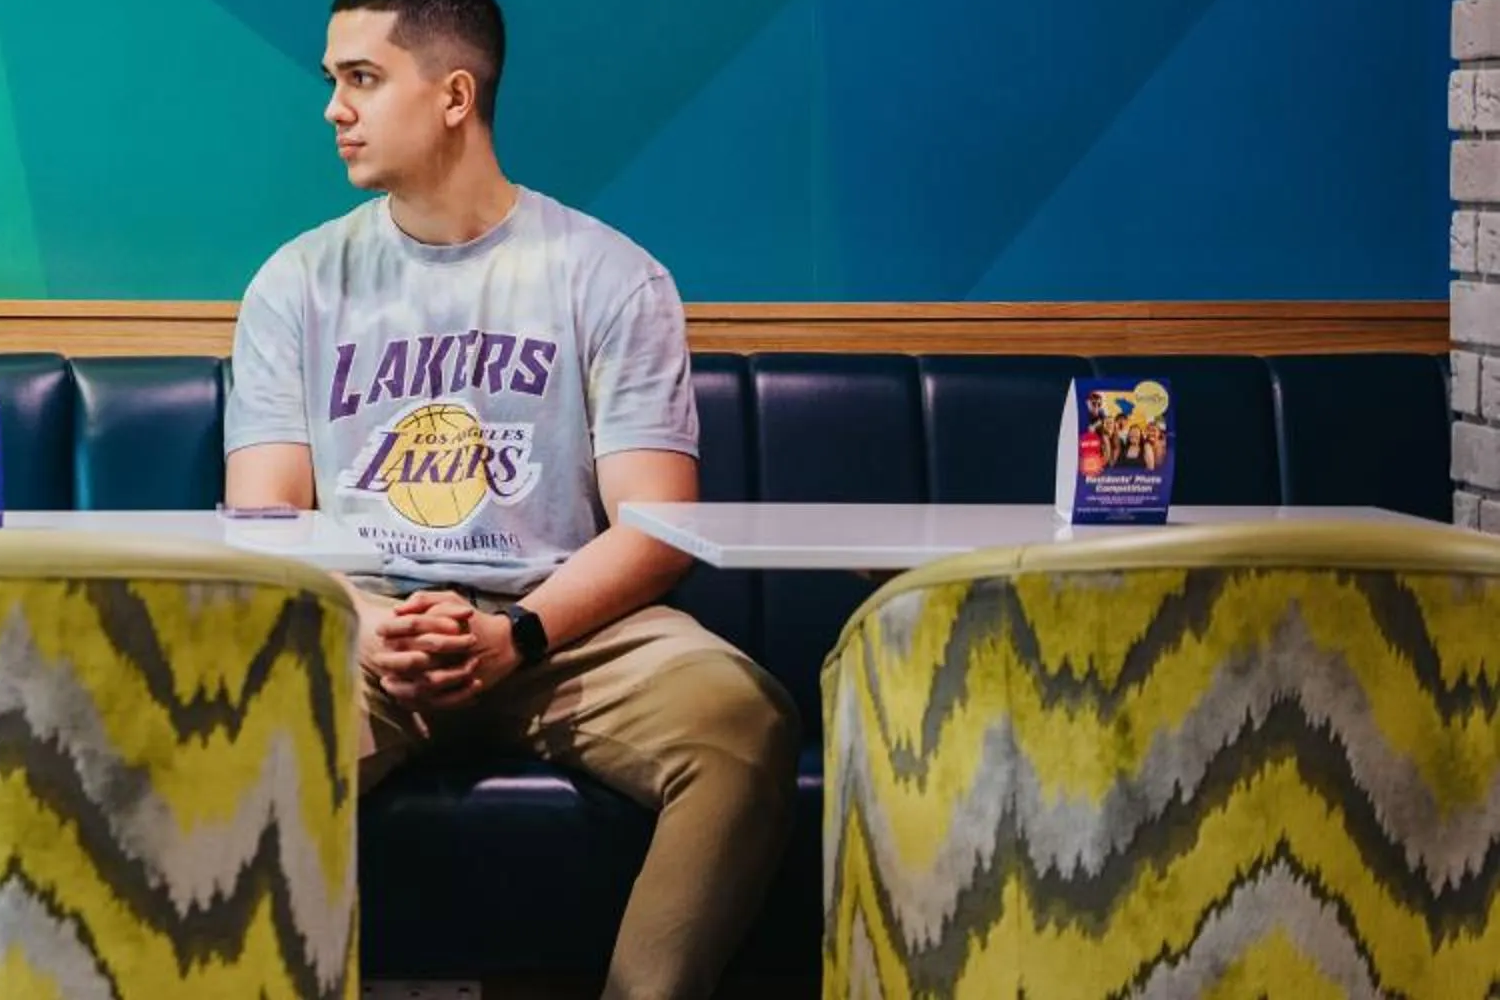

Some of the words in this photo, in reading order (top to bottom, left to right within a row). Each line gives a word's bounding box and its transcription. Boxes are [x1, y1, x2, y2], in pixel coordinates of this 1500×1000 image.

[329, 329, 557, 422] LAKERS
[414, 433, 448, 445] LOS
[346, 431, 532, 497] LAKERS
[1133, 475, 1162, 485] Photo
[1095, 484, 1153, 494] Competition
